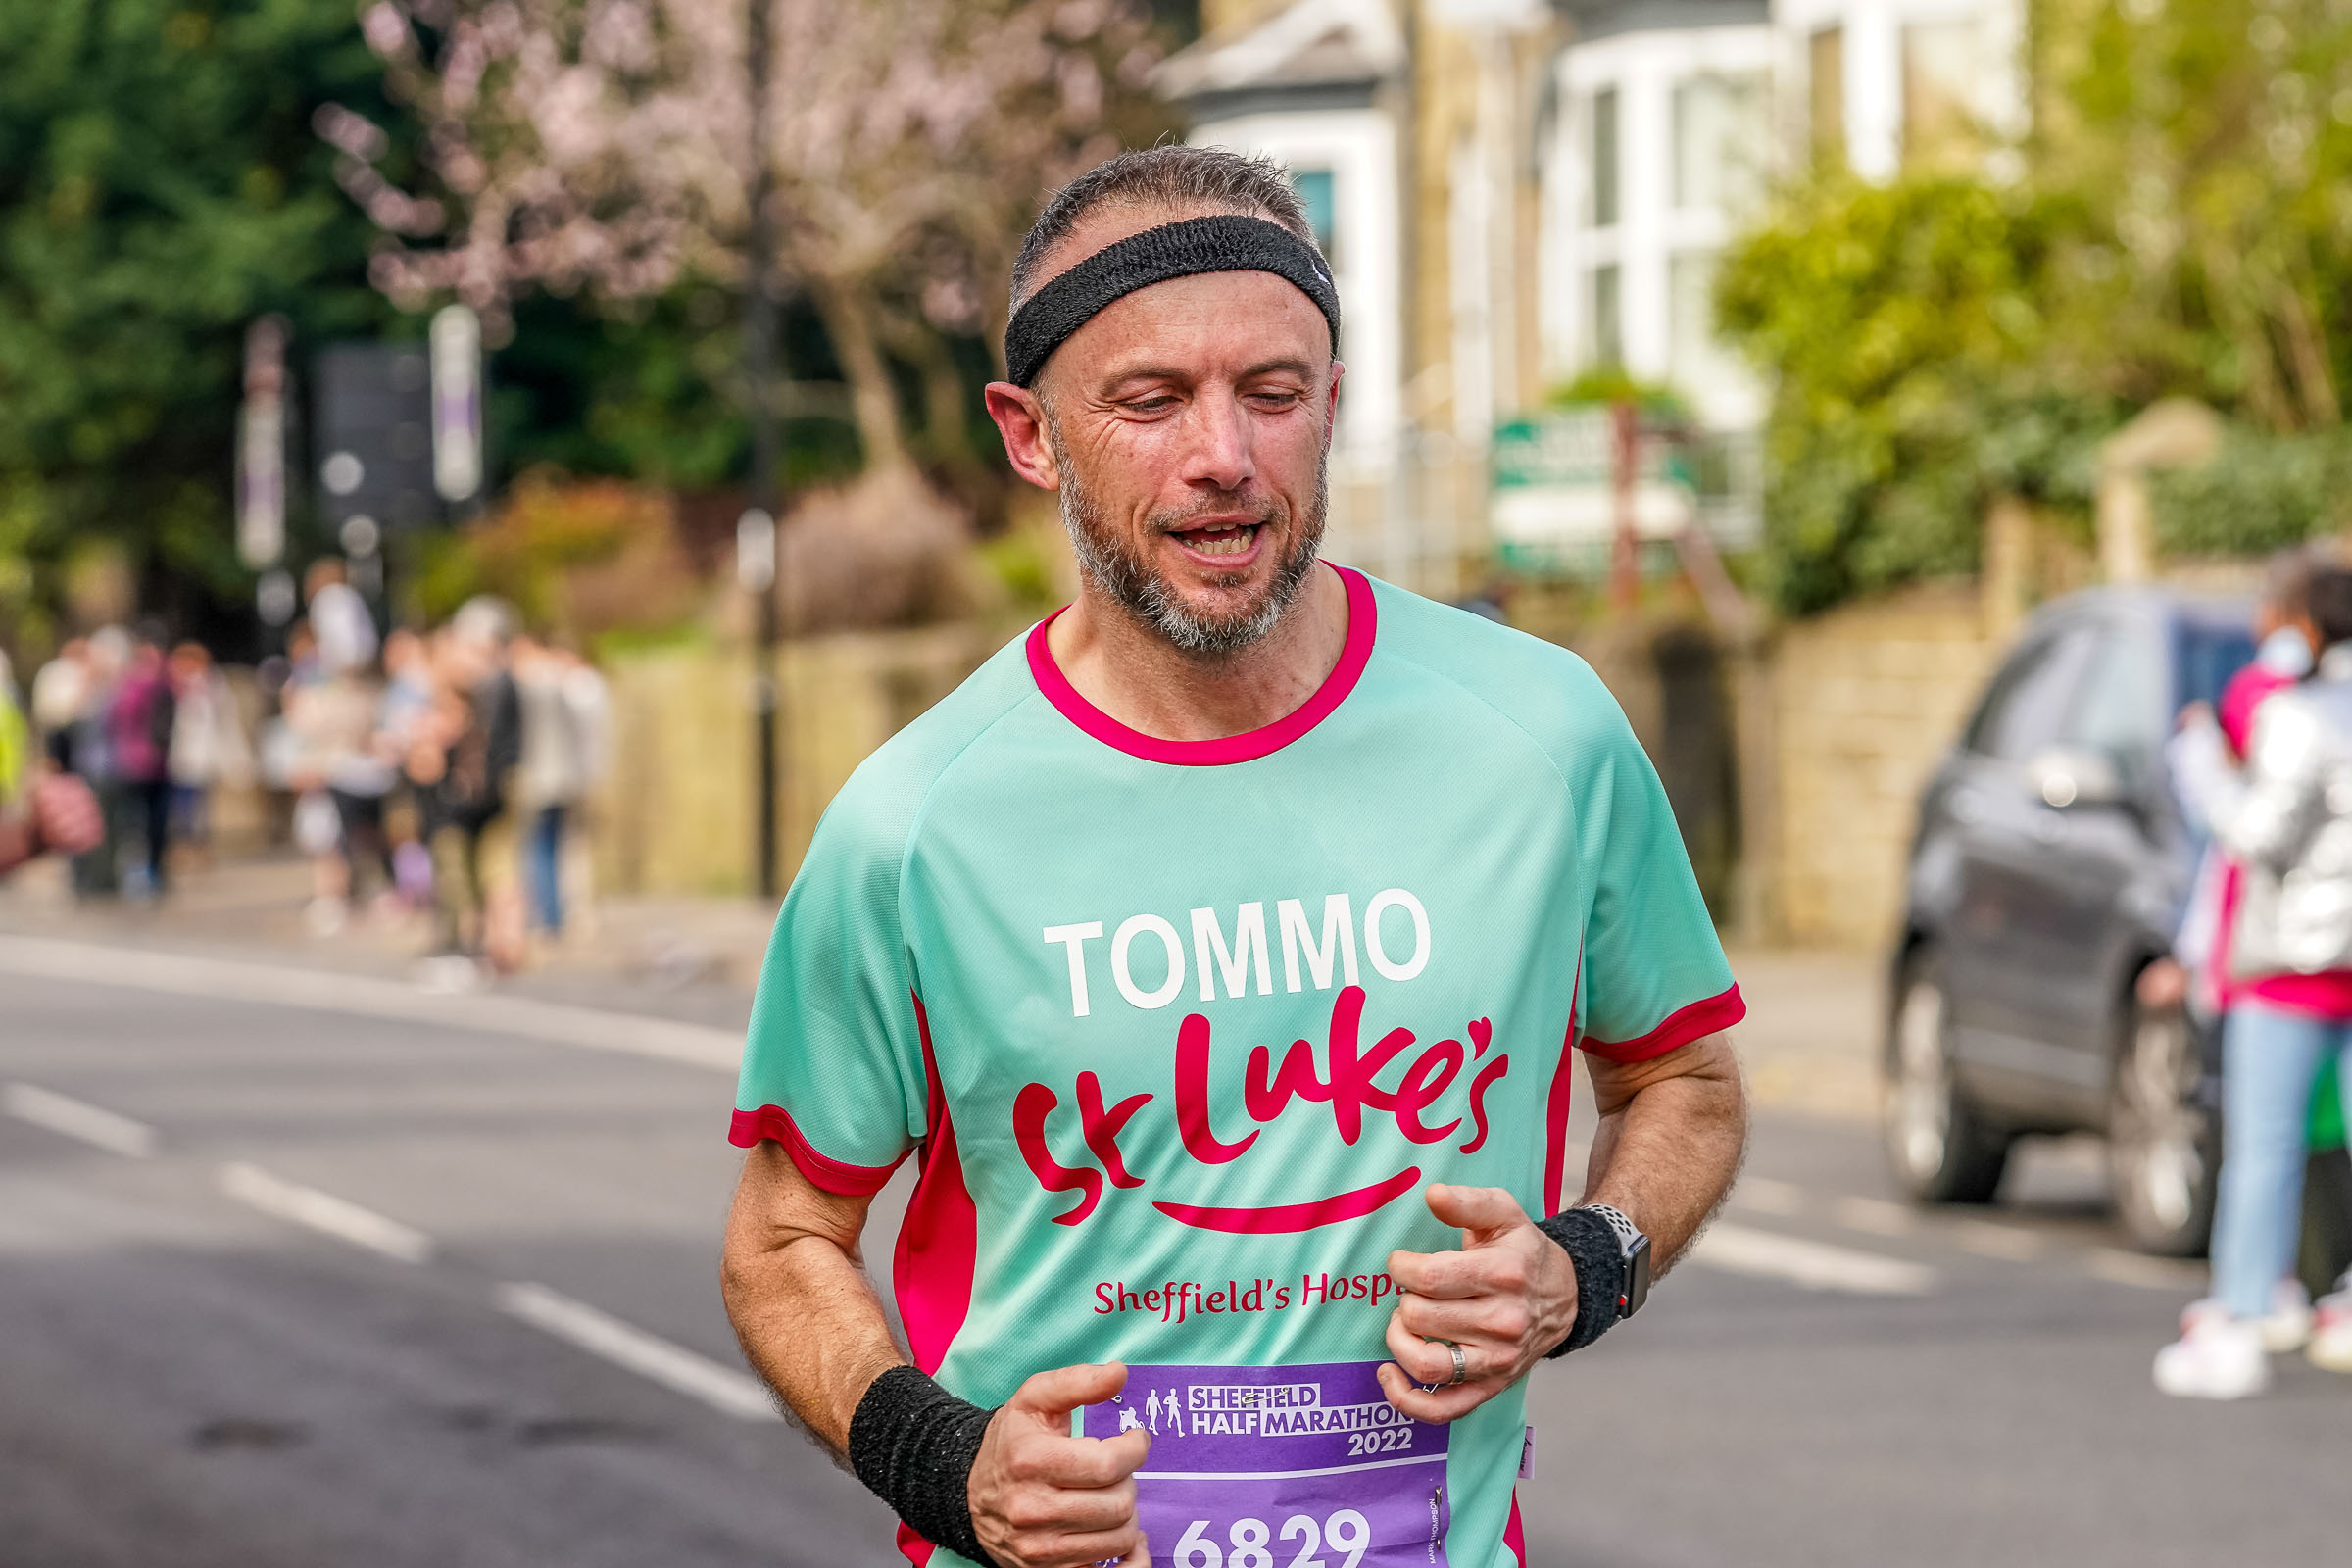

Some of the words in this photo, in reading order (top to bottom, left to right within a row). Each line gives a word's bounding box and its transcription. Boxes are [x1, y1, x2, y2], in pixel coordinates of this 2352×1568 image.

[1042, 888, 1432, 1018] TOMMO
[1012, 1070, 1154, 1227] St
[1175, 985, 1509, 1165] Luke's
[1094, 1278, 1290, 1324] Sheffield's
[1192, 1386, 1317, 1409] SHEFFIELD
[1192, 1412, 1258, 1435] HALF
[1348, 1427, 1413, 1456] 2022
[1172, 1508, 1371, 1568] 6829
